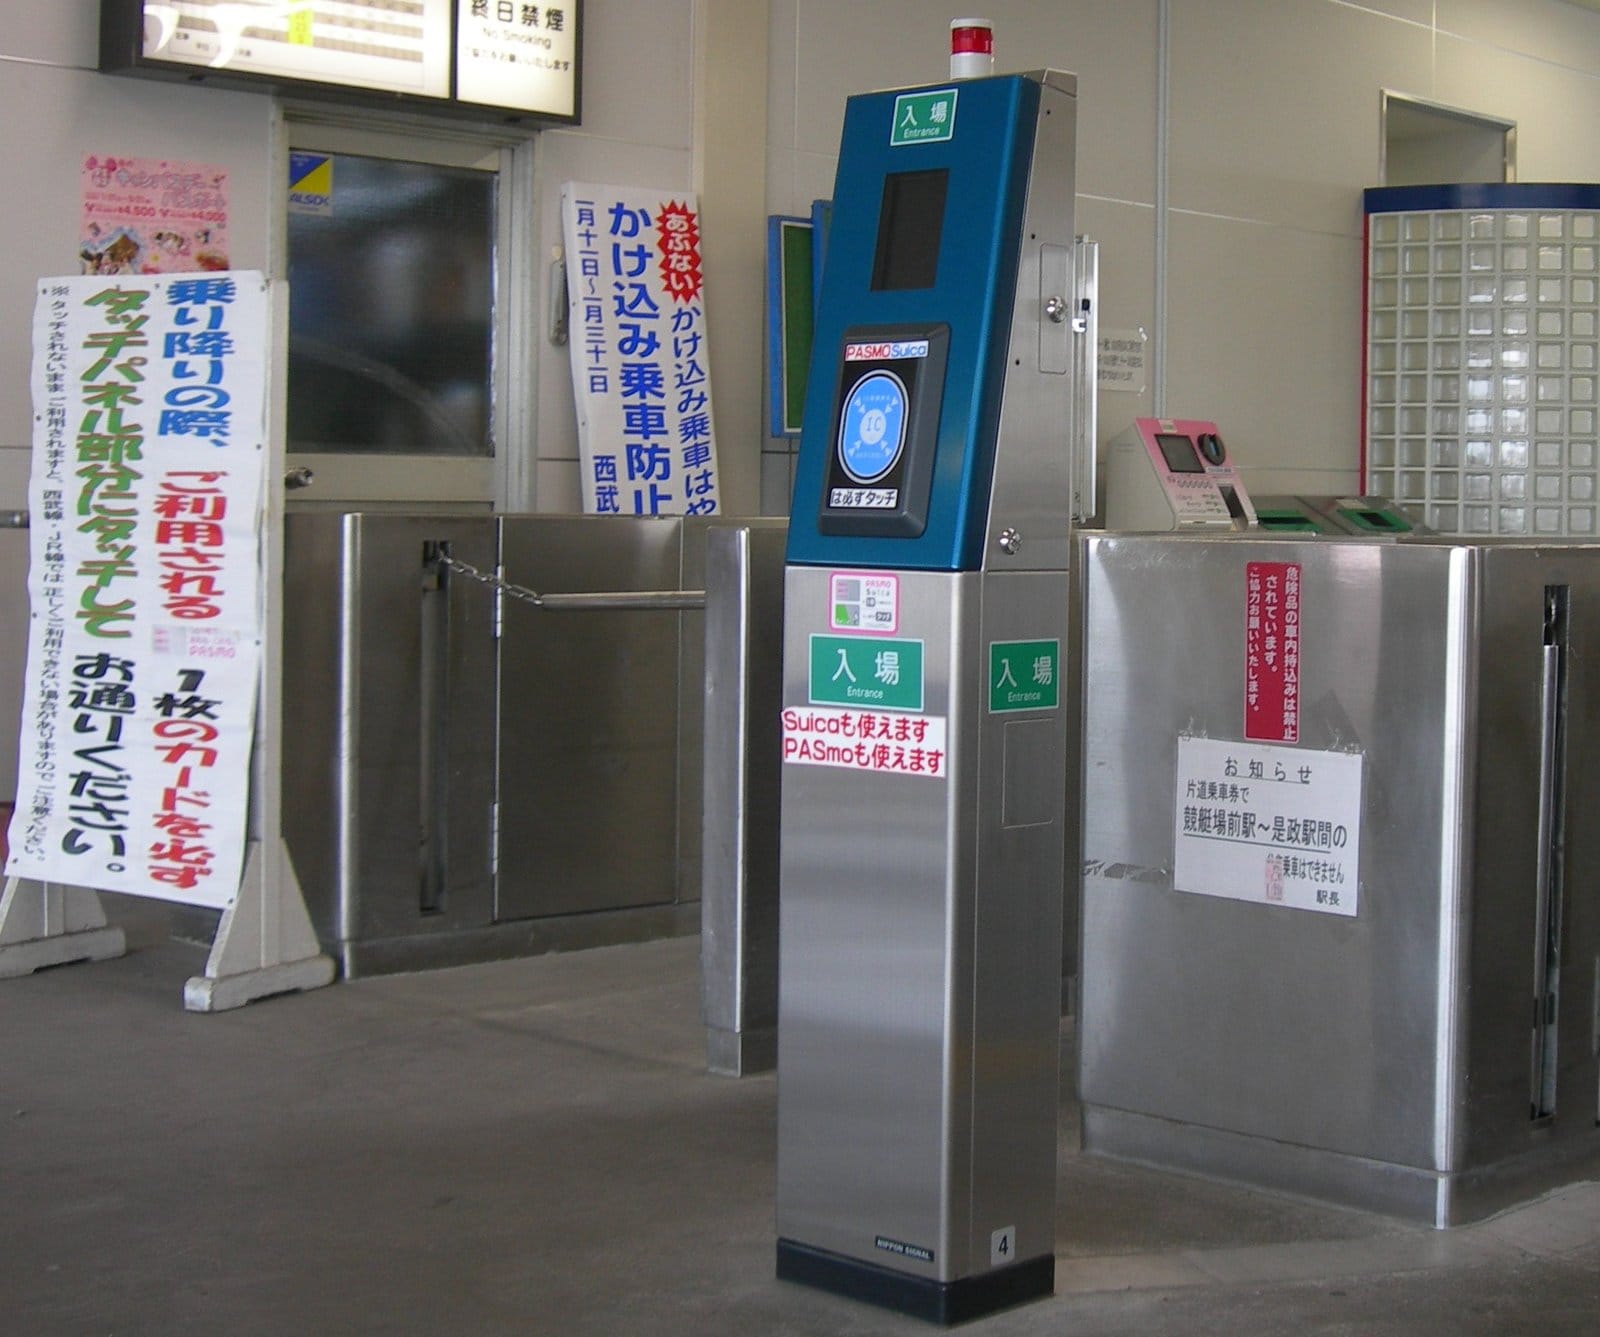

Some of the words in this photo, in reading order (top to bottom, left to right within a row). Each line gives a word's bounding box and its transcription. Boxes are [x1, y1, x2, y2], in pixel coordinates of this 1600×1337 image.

[471, 0, 564, 32] 終日禁煙
[901, 101, 947, 128] 入場
[903, 127, 940, 138] Entrance
[665, 212, 694, 290] あぶない
[158, 277, 237, 447] 乗り降りの際、
[608, 202, 673, 517] かけ込み乗車防止
[847, 345, 891, 359] PASMO
[890, 344, 926, 357] Suica
[866, 417, 881, 432] IC
[76, 287, 150, 639] タッチパネル部分にタッチして
[831, 490, 896, 506] は必ずタッチ
[152, 470, 230, 619] ご利用される
[1265, 575, 1278, 673] されています。
[832, 649, 900, 685] 入場
[996, 656, 1052, 689] 入場
[847, 686, 884, 699] Entrance
[1007, 691, 1041, 702] Entrance
[784, 711, 929, 742] Suicaも使えます
[61, 652, 137, 873] お通りください。
[784, 738, 944, 774] PASmoも使えます
[1224, 756, 1312, 784] お知らせ
[1186, 779, 1250, 804] 片道乗車券で
[1316, 888, 1340, 906] 駅長
[998, 1234, 1009, 1256] 4
